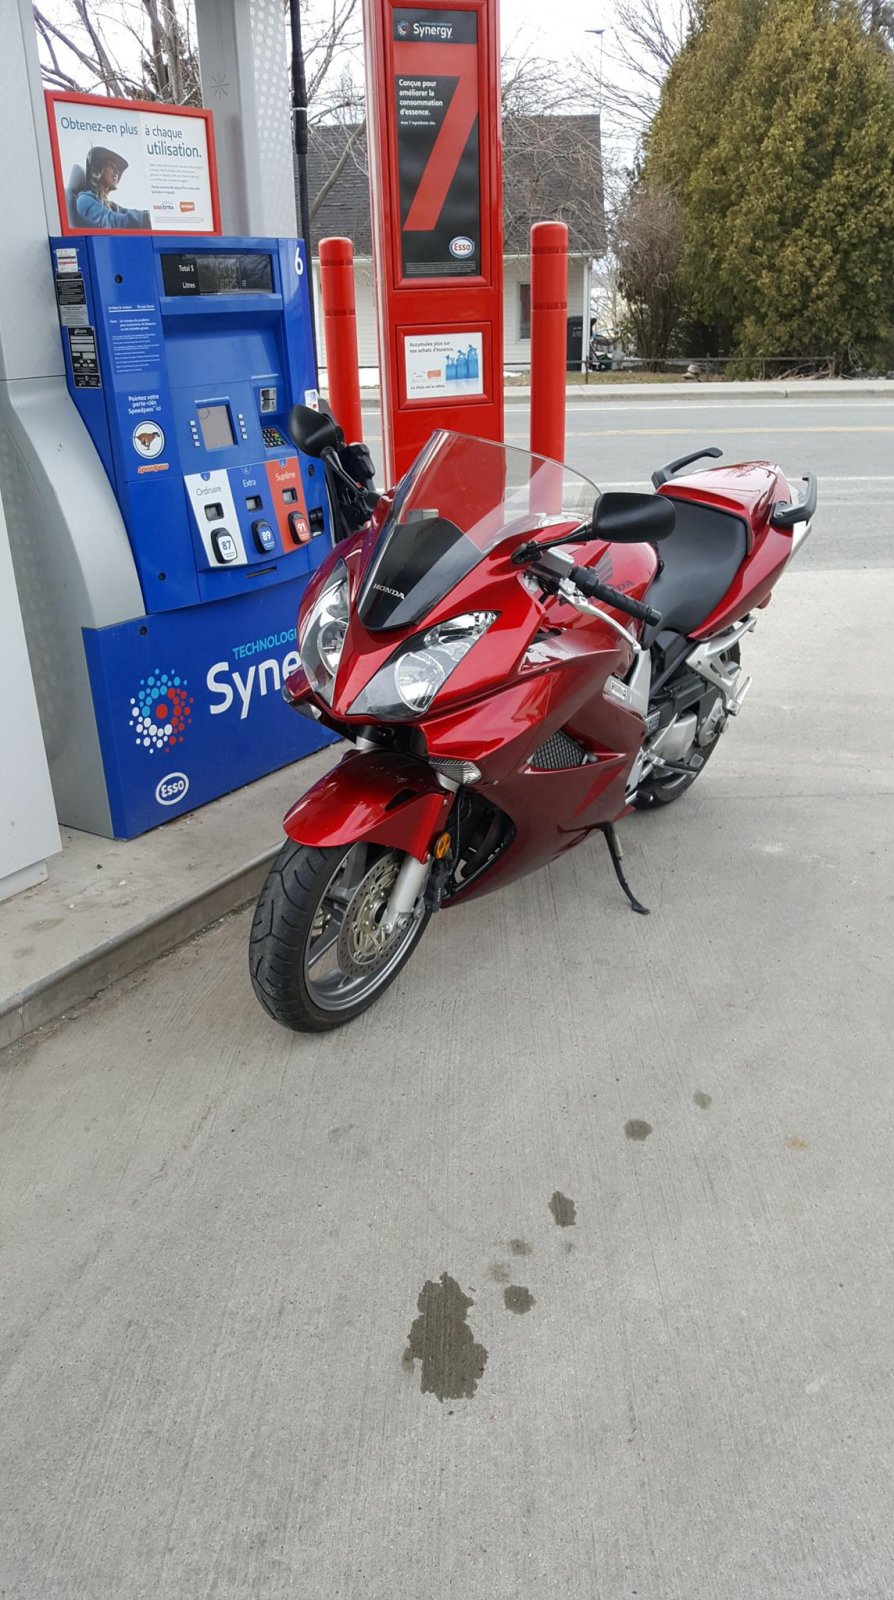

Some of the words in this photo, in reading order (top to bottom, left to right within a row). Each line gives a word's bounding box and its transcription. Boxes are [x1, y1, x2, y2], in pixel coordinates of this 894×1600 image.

[413, 23, 452, 39] Synergy
[398, 79, 421, 88] Conçue
[422, 80, 437, 89] pour
[398, 88, 428, 97] améliorer
[428, 89, 435, 97] la
[399, 98, 443, 107] consommation
[60, 116, 118, 134] Obtenez-en
[120, 122, 138, 137] plus
[145, 124, 150, 136] à
[152, 126, 183, 142] chaque
[147, 143, 202, 158] utilisation.
[294, 247, 304, 276] 6
[178, 264, 190, 272] Total
[275, 471, 296, 482] Suprême
[242, 479, 257, 488] Extra
[196, 486, 222, 496] Ordinaire
[297, 522, 306, 532] 91
[261, 530, 272, 541] 89
[221, 540, 232, 551] 87
[372, 583, 405, 600] HONDA
[231, 627, 297, 660] TECHNOLOGI
[206, 650, 301, 720] Syne
[161, 780, 185, 798] Esso
